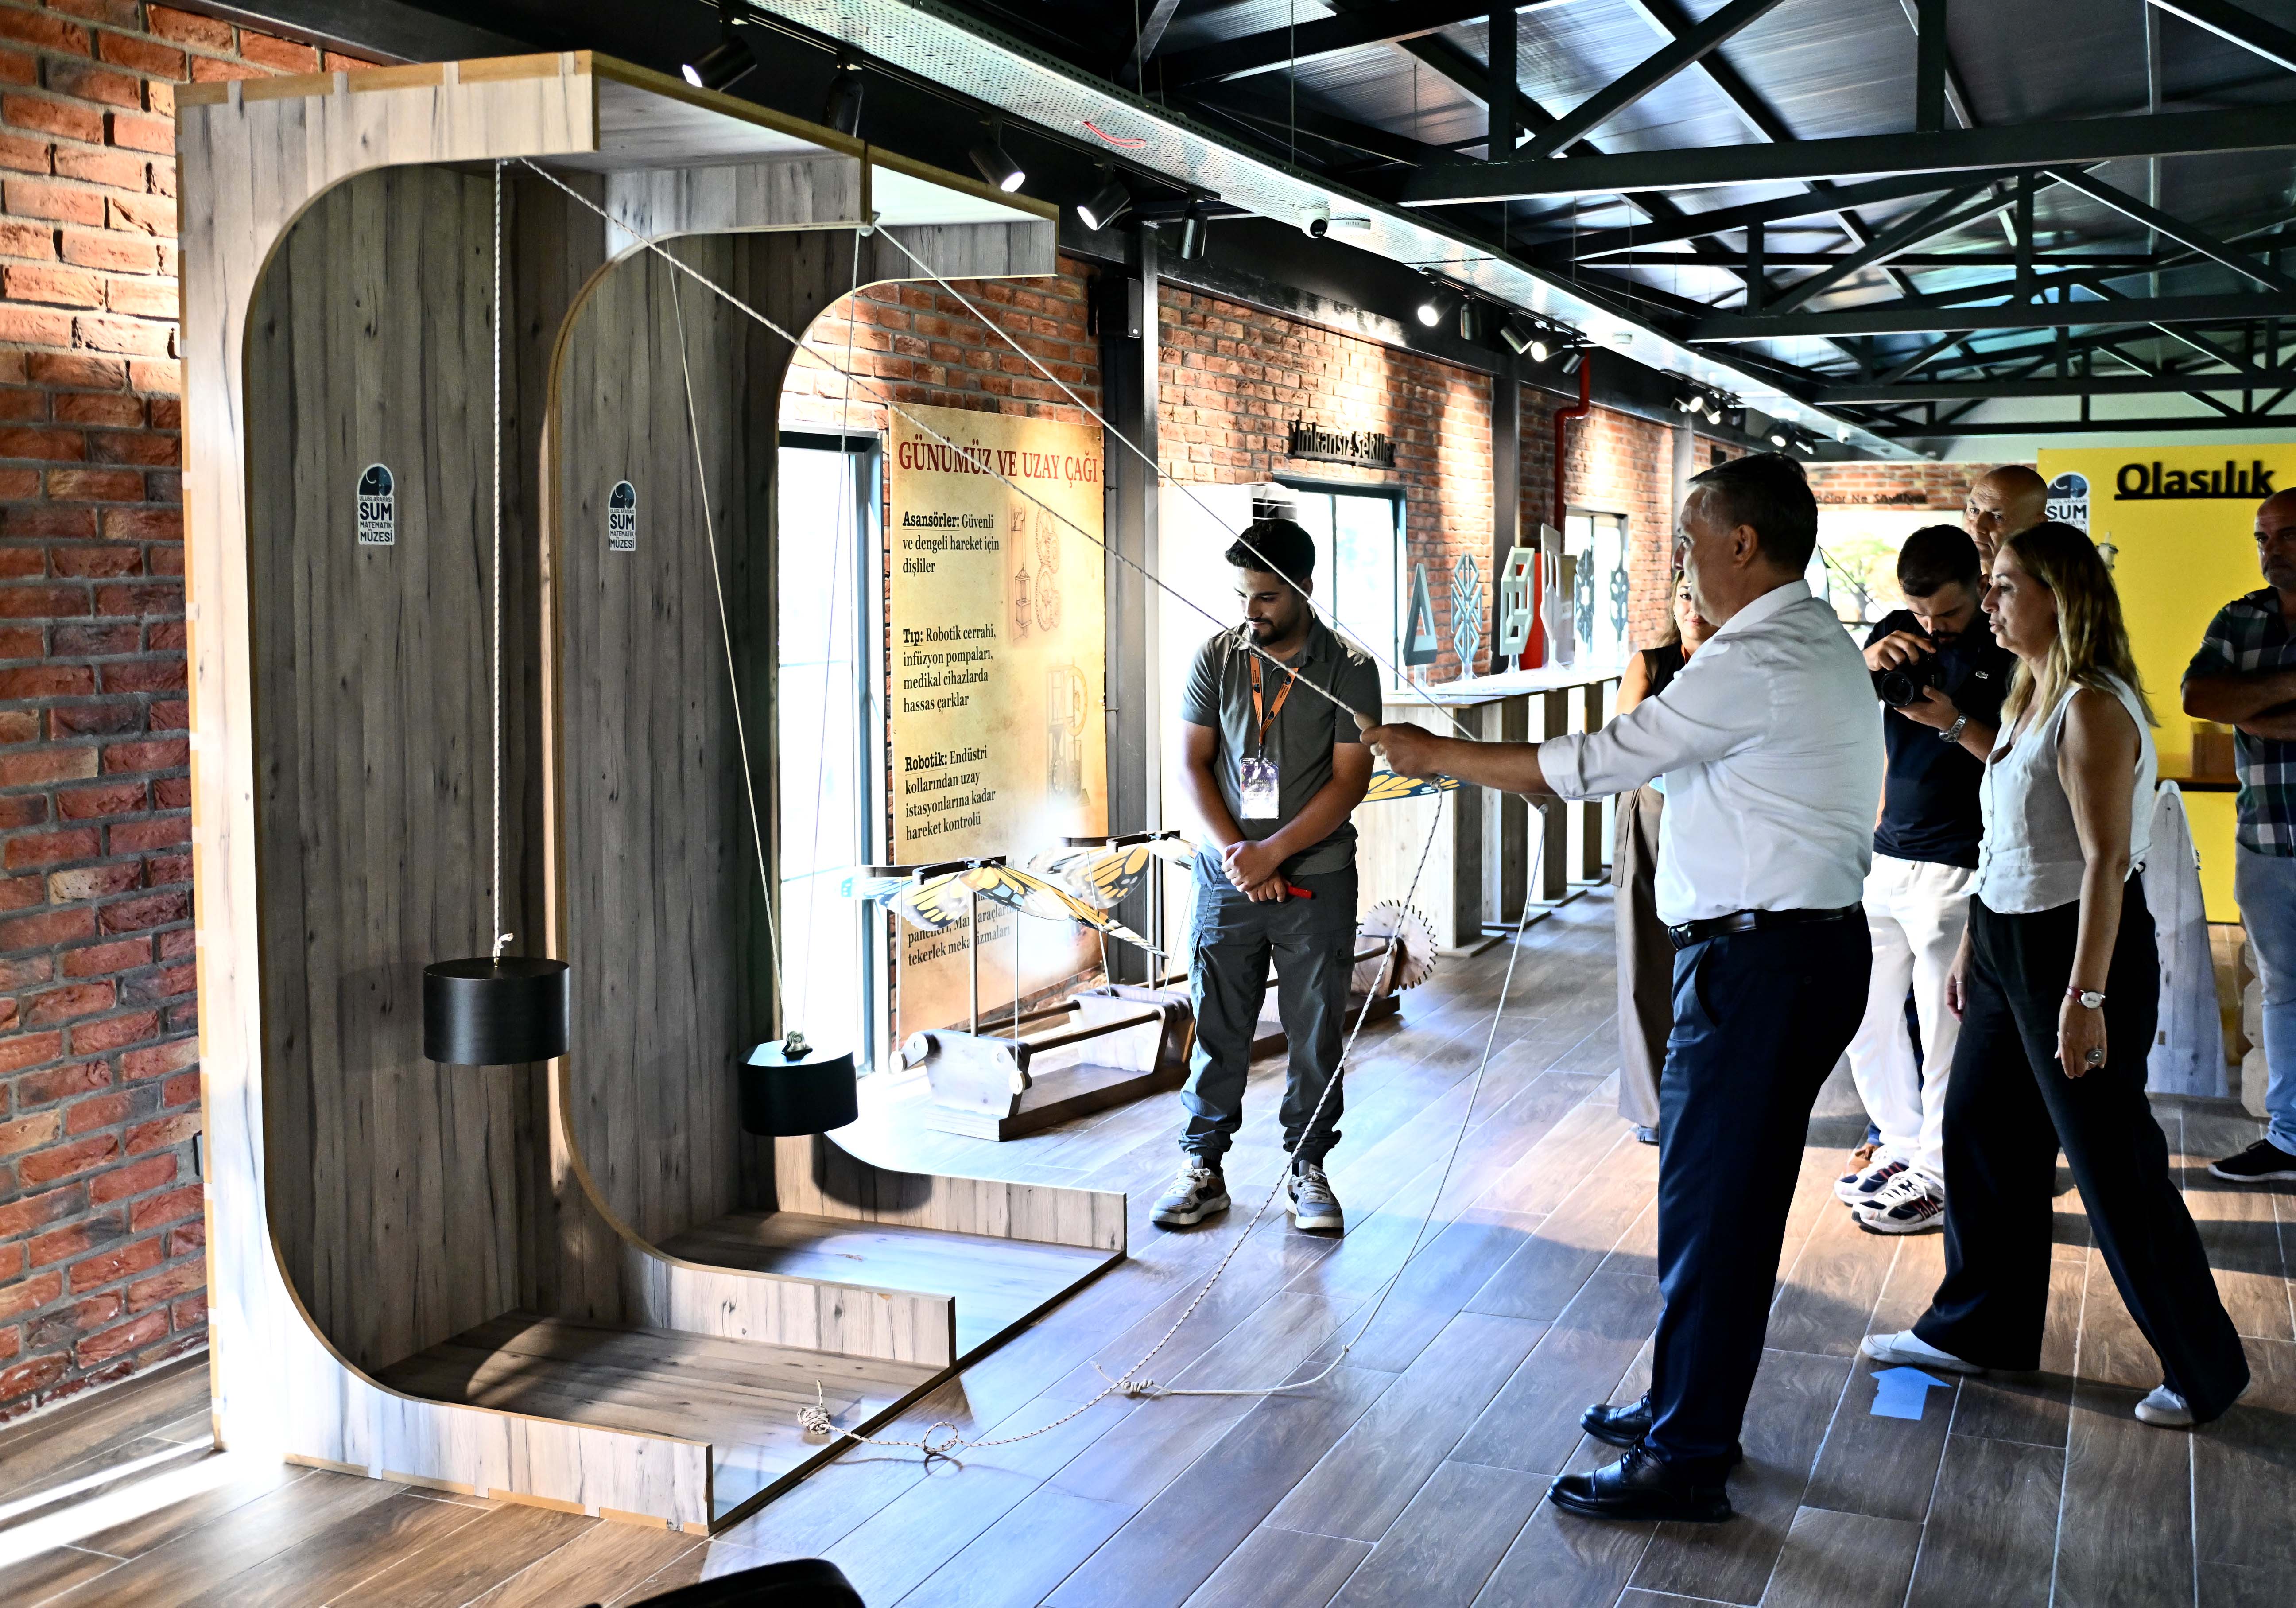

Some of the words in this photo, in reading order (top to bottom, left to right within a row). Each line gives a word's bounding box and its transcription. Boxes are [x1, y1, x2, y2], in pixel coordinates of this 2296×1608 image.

[899, 433, 992, 474] GÜNÜMÜZ
[997, 450, 1017, 477] VE
[1022, 452, 1060, 479] UZAY
[1065, 450, 1098, 488] ÇAĞI
[2116, 461, 2276, 498] Olasılık
[360, 501, 392, 521] SUM
[902, 511, 959, 527] Asansörler:
[962, 514, 993, 528] Güvenli
[2047, 505, 2087, 519] SUM
[610, 514, 634, 530] SUM
[360, 529, 392, 543] MÜZESİ
[610, 537, 634, 548] MÜZESİ
[903, 539, 913, 550] ve
[915, 535, 948, 554] dengeli
[950, 535, 982, 550] hareket
[984, 536, 1000, 554] için
[903, 558, 935, 577] dişliler
[903, 628, 923, 646] Tıp:
[926, 625, 961, 642] Robotik
[963, 623, 996, 641] cerrahi,
[904, 650, 944, 668] infüzyon
[946, 646, 993, 667] pompaları,
[904, 672, 941, 689] medikal
[943, 668, 988, 685] cihazlarda
[904, 698, 935, 712] hassas
[937, 692, 969, 712] çarklar
[905, 752, 947, 772] Robotik:
[950, 745, 987, 765] Endüstri
[905, 773, 958, 795] kollarından
[961, 772, 981, 785] uzay
[906, 796, 970, 818] istasyonlarına
[971, 788, 996, 804] kadar
[906, 821, 941, 841] hareket
[943, 811, 981, 832] kontrolü
[908, 942, 946, 966] tekerlek
[948, 925, 1010, 954] mekaizmaları
